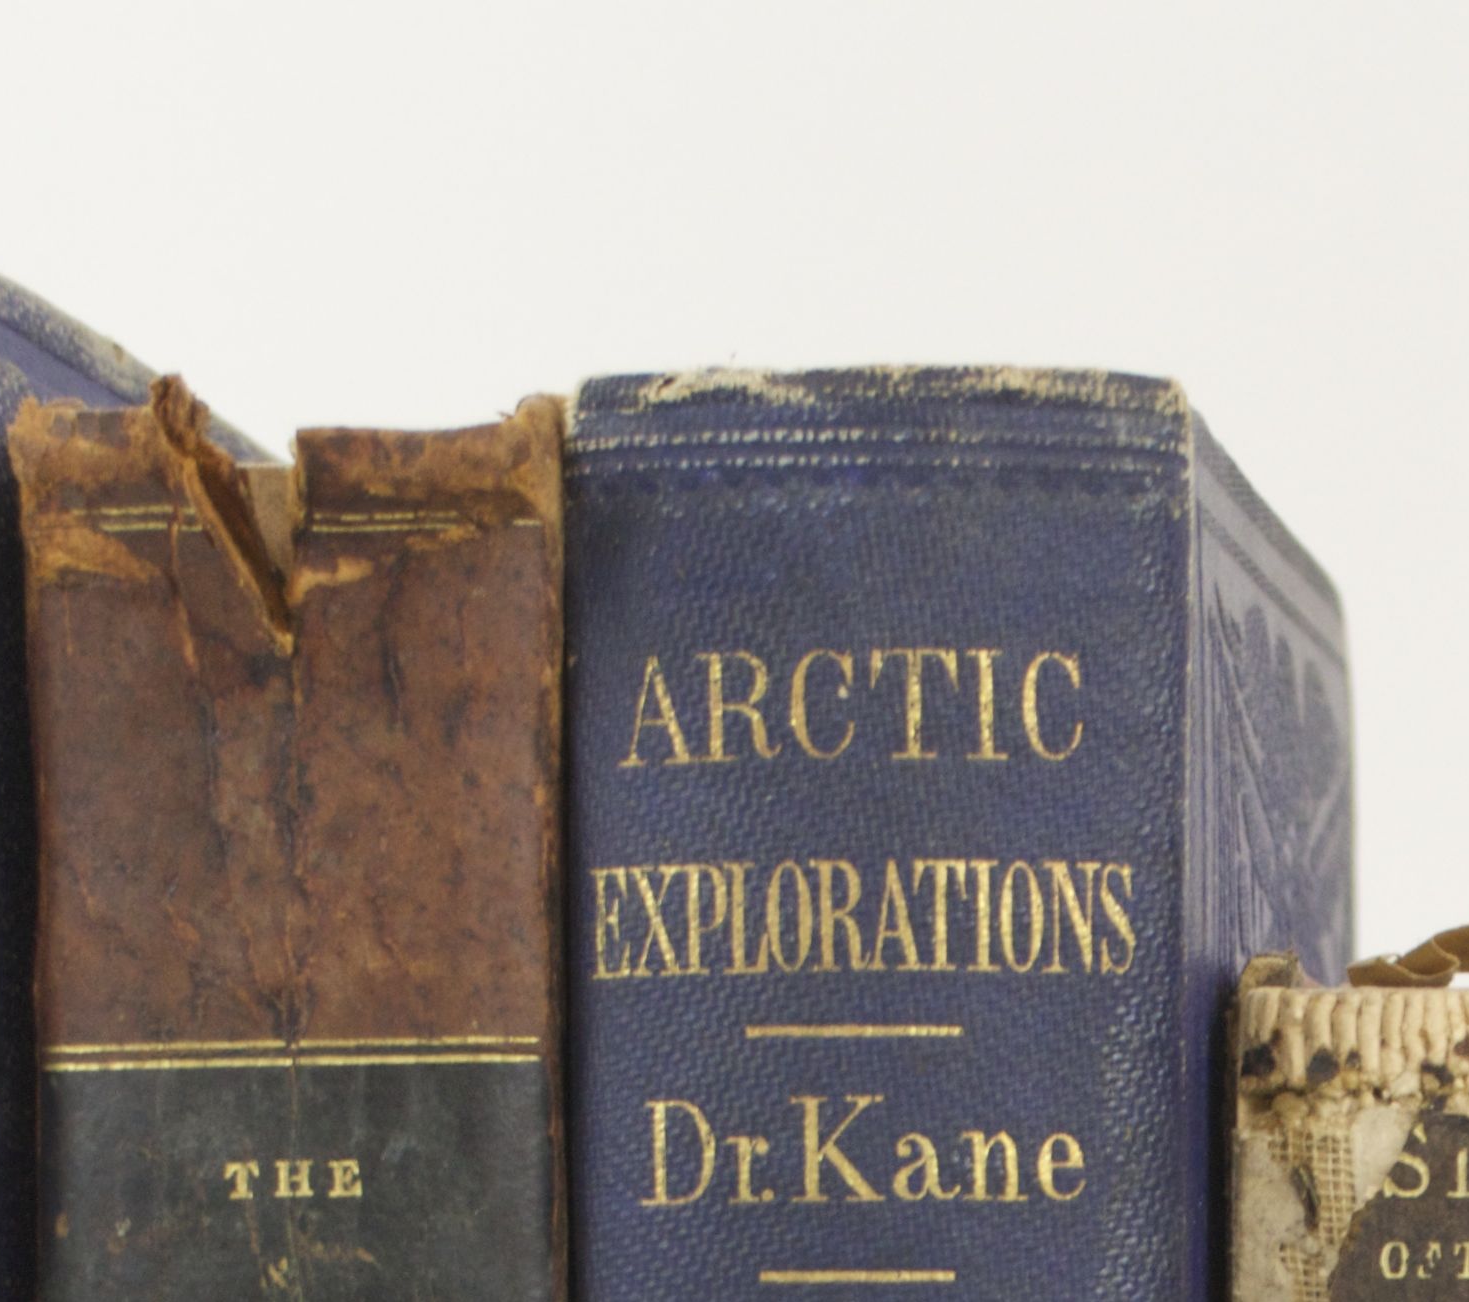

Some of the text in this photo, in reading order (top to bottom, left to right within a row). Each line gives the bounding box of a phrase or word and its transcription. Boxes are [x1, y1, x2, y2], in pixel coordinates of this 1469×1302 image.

[618, 648, 1083, 768] ARCTIC
[590, 858, 1136, 980] EXPLORATIONS
[224, 1159, 363, 1200] THE
